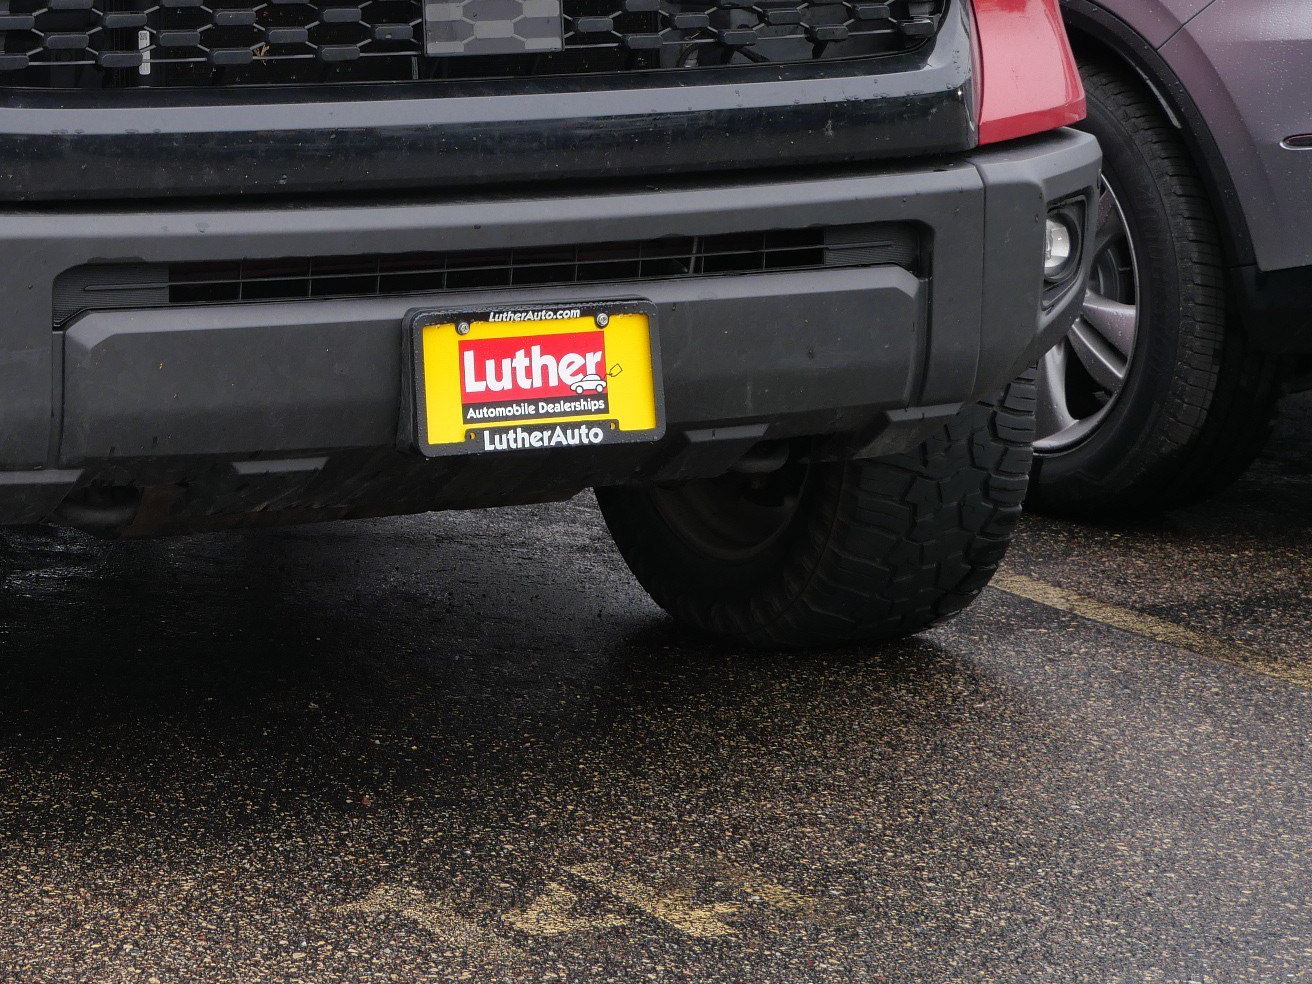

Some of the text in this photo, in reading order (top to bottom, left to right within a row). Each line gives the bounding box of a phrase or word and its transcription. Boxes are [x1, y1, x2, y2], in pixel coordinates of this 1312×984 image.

[489, 309, 580, 322] LutherAuto.com
[463, 345, 603, 392] Luther
[466, 398, 605, 419] Automobile Dealerships
[484, 425, 604, 451] LutherAuto
